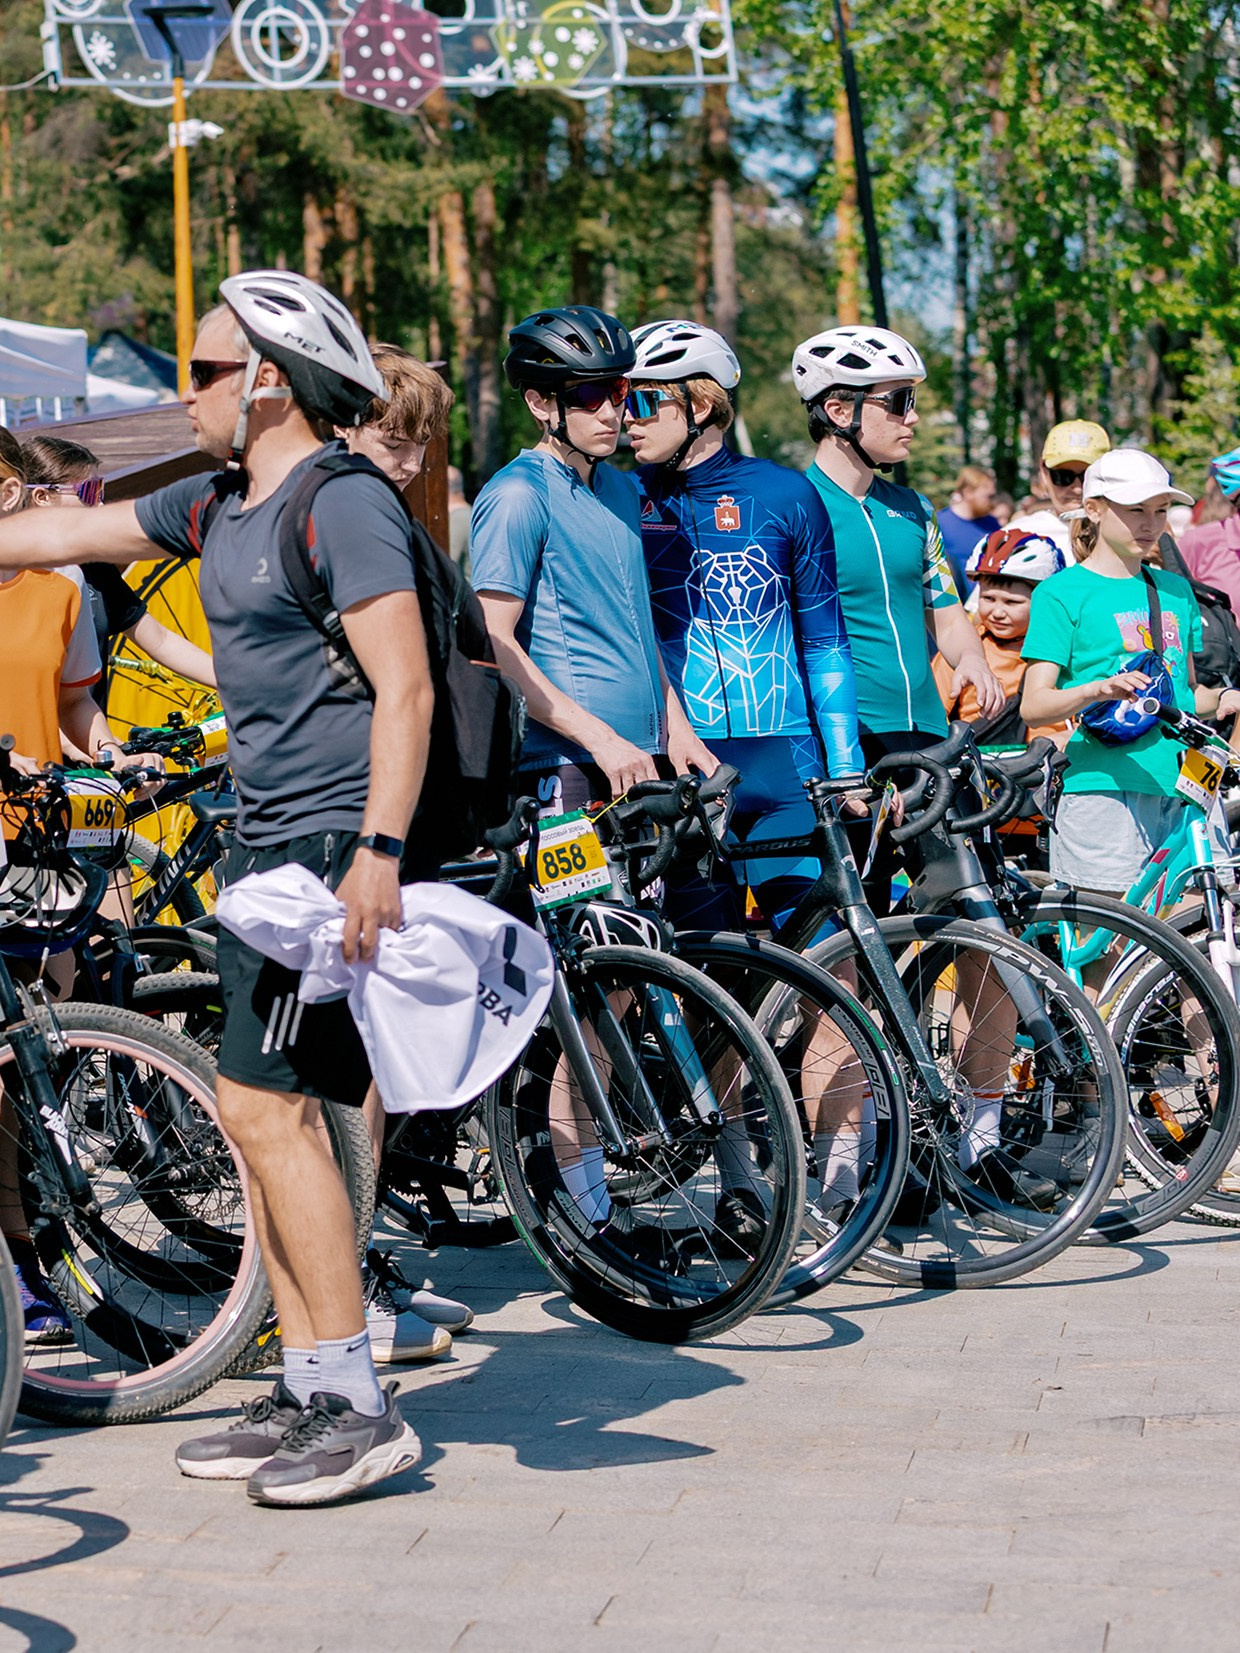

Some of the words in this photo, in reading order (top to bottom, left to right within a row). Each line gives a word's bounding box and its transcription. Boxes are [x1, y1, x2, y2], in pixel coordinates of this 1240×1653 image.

[283, 331, 326, 353] MET
[850, 339, 878, 357] SMITH
[84, 798, 113, 827] 669
[542, 843, 586, 879] 858
